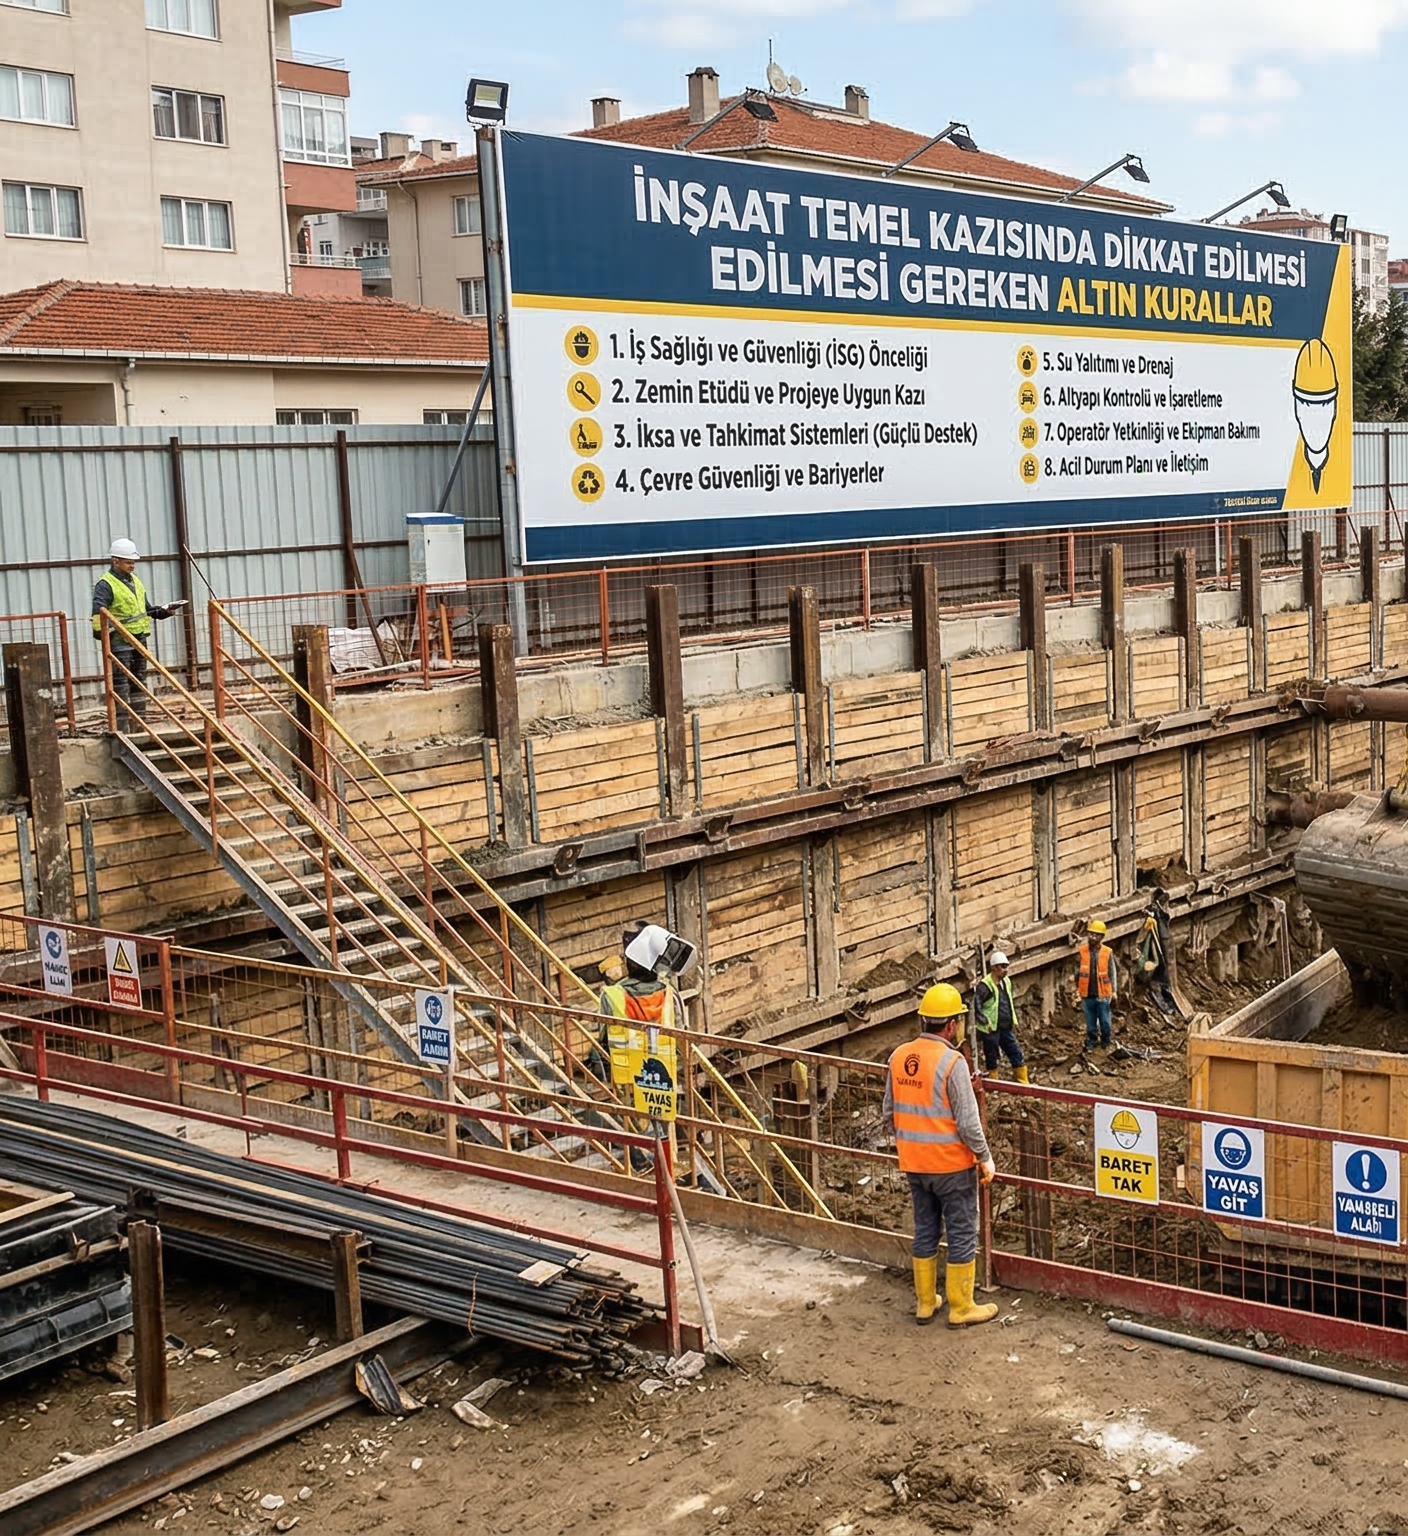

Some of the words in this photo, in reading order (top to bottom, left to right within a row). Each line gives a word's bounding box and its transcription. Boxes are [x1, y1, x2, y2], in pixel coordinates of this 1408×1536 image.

[633, 164, 791, 237] İNŞAAT
[800, 195, 921, 248] TEMEL
[930, 210, 1098, 265] KAZISINDA
[1104, 226, 1198, 276] DİKKAT
[1204, 241, 1307, 288] EDİLMESİ
[710, 240, 890, 301] EDİLMESİ
[900, 263, 1049, 312] GEREKEN
[1057, 277, 1137, 318] ALTIN
[1144, 284, 1273, 327] KURALLAR
[610, 333, 625, 359] 1.
[630, 329, 645, 366] İş
[650, 335, 713, 367] Sağlığı
[718, 343, 738, 363] ve
[743, 338, 821, 369] Güvenliği
[825, 337, 865, 369] (İSG)
[869, 338, 928, 372] Önceliği
[1043, 352, 1054, 372] 5.
[1057, 352, 1072, 372] Su
[1075, 352, 1119, 374] Yalıtımı
[1123, 358, 1136, 374] ve
[1138, 356, 1174, 379] Drenaj
[612, 379, 630, 405] 2.
[635, 378, 693, 405] Zemin
[699, 379, 750, 405] Etüdü
[754, 386, 774, 405] ve
[779, 382, 839, 411] Projeye
[843, 383, 891, 411] Uygun
[895, 384, 925, 406] Kazı
[1043, 387, 1055, 406] 6.
[1058, 387, 1101, 410] Altyapı
[1103, 387, 1151, 408] Kontrolü
[1153, 393, 1167, 408] ve
[1169, 385, 1223, 411] İşaretleme
[614, 423, 632, 449] 3.
[637, 417, 675, 449] İksa
[680, 429, 701, 448] ve
[706, 421, 786, 447] Tahkimat
[790, 422, 869, 446] Sistemleri
[873, 422, 920, 449] (Güçlü
[924, 422, 978, 447] Destek)
[1044, 423, 1055, 442] 7.
[1112, 422, 1165, 444] Yetkinliği
[1167, 428, 1180, 441] ve
[1182, 422, 1226, 444] Ekipman
[1228, 422, 1261, 440] Bakımı
[1044, 458, 1057, 476] 8.
[1059, 457, 1082, 476] Acil
[1084, 457, 1123, 475] Durum
[1126, 455, 1153, 474] Planı
[1155, 460, 1168, 473] ve
[1170, 451, 1209, 475] İletişim
[615, 468, 635, 493] 4.
[640, 467, 693, 496] Çevre
[698, 463, 780, 492] Güvenliği
[784, 469, 804, 487] ve
[809, 462, 884, 487] Bariyerler
[1100, 1155, 1152, 1175] BARET
[1111, 1176, 1142, 1193] TAK
[1207, 1174, 1260, 1199] YAVAŞ
[1220, 1193, 1248, 1212] GİT
